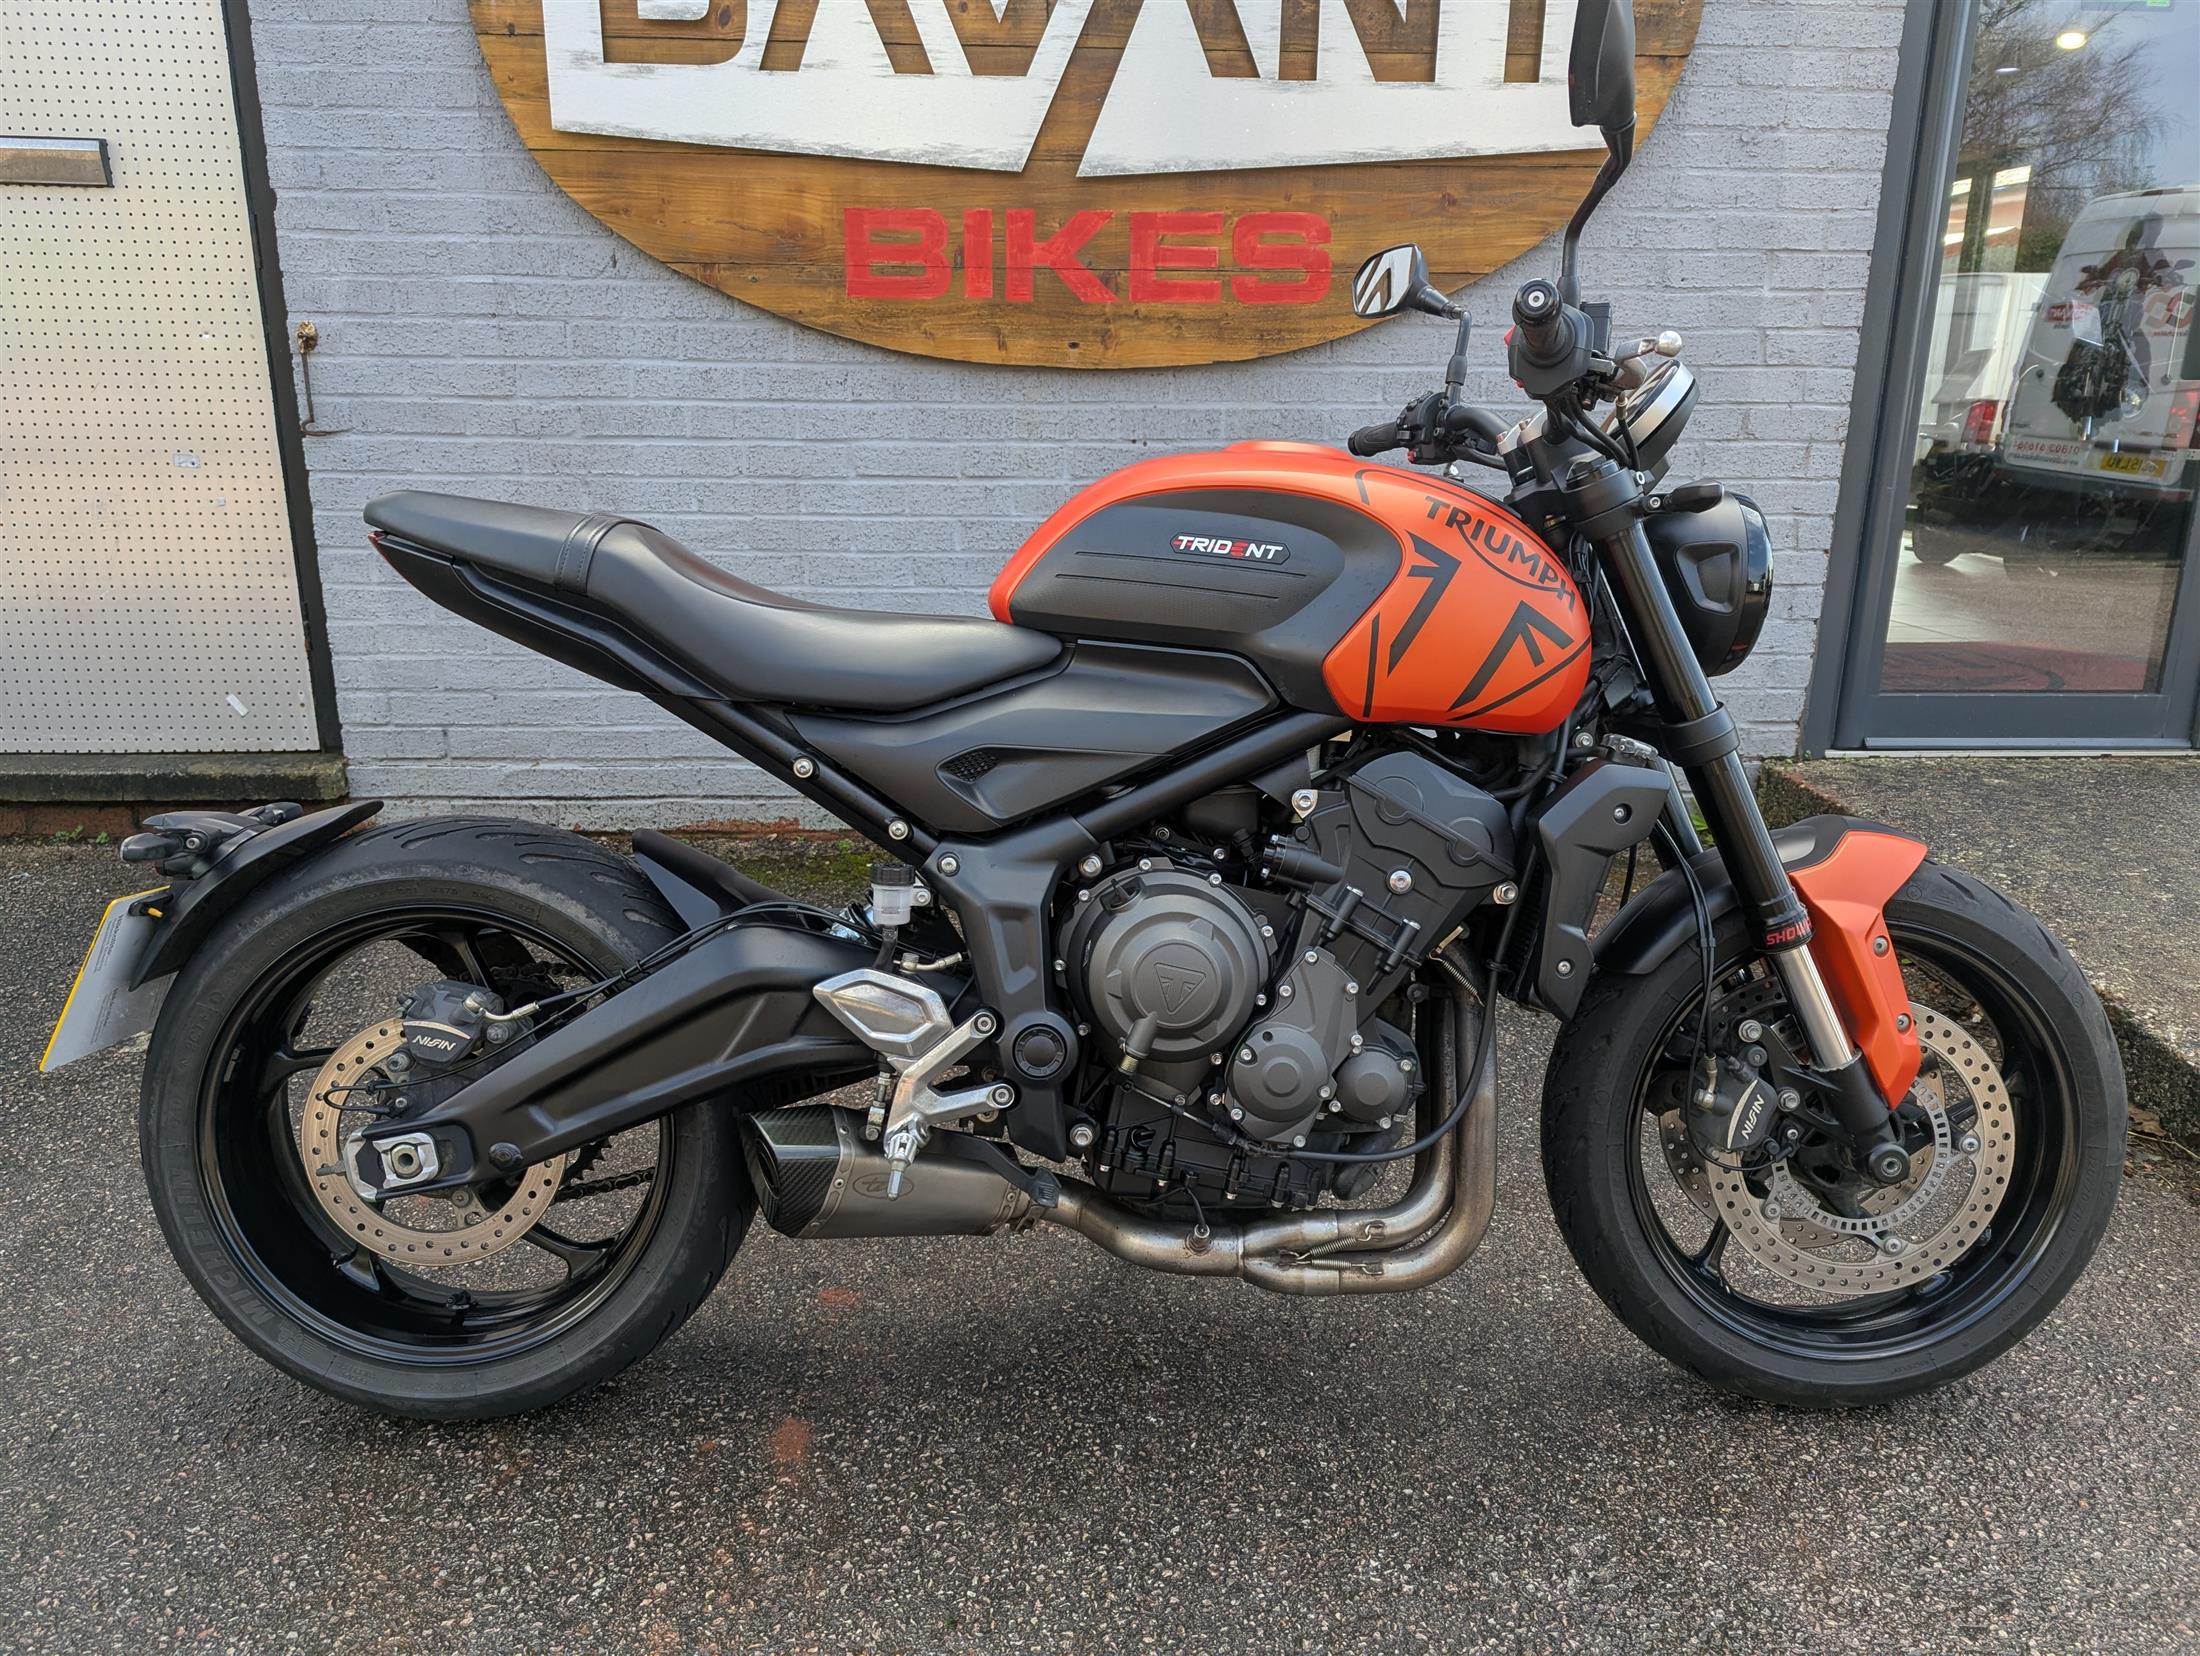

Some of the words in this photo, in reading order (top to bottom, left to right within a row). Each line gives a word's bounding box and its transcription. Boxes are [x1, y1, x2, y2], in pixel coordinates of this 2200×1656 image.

[844, 207, 1333, 305] BIKES
[1173, 535, 1284, 560] TRIDENT
[1424, 495, 1576, 612] TRIUMPH
[168, 1166, 276, 1326] MICHELIN
